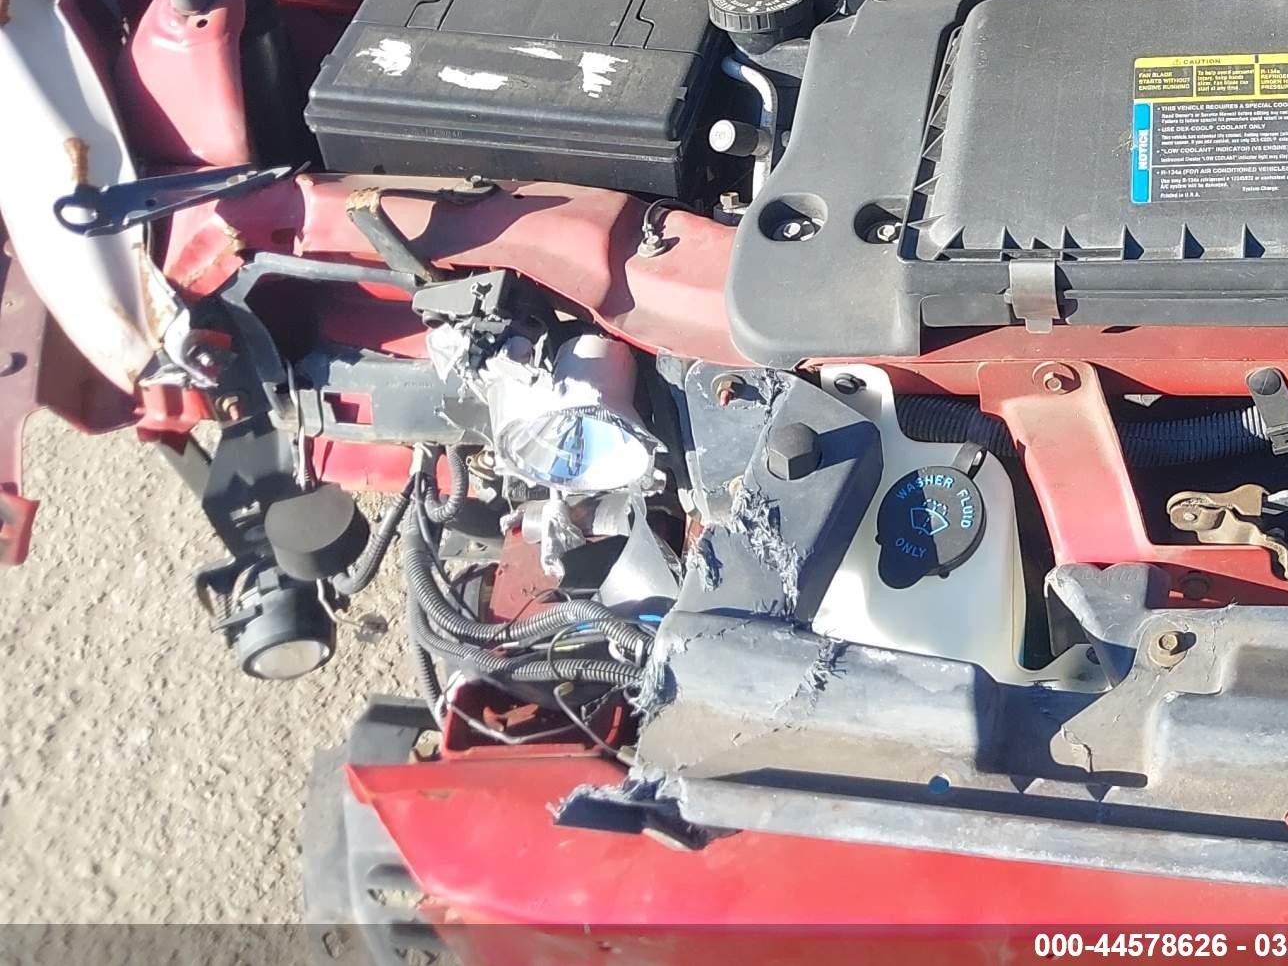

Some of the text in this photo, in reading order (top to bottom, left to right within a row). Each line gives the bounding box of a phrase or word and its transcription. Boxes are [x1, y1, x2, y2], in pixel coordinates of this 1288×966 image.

[1138, 129, 1150, 170] NOTICE
[896, 474, 974, 528] WASHER FLUID
[895, 538, 927, 559] ONLY
